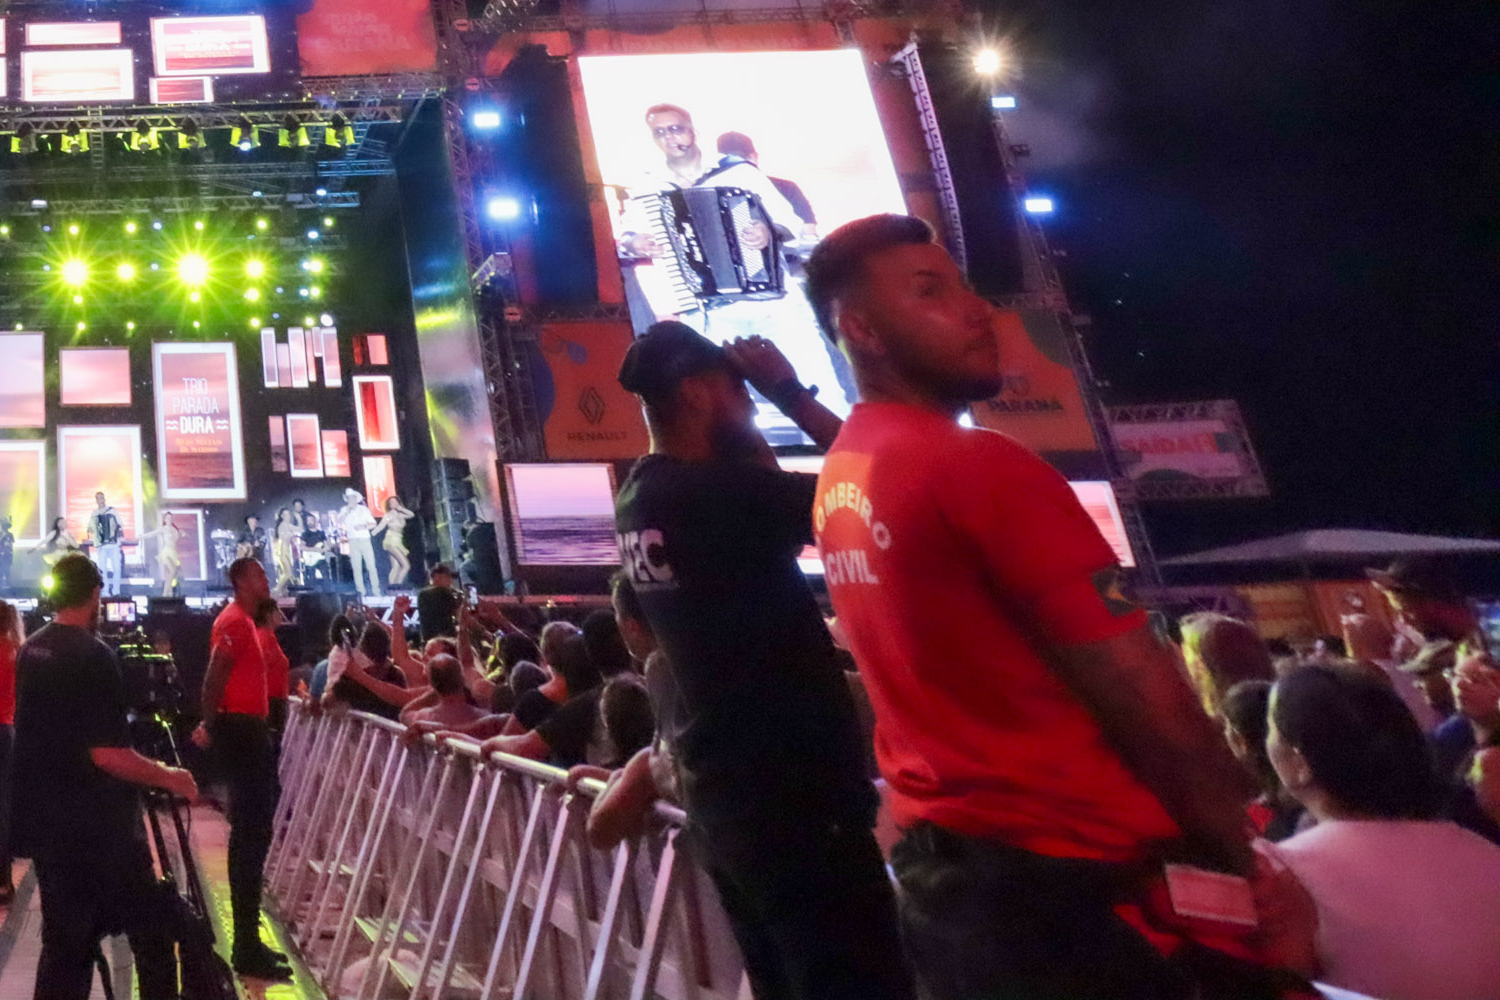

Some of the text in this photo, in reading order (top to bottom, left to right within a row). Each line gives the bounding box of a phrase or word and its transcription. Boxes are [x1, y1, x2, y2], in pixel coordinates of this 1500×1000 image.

[182, 378, 208, 395] TRIO
[172, 397, 219, 414] PARADA
[180, 416, 214, 434] DURA
[814, 482, 891, 550] OMBEIRO
[826, 549, 879, 586] CIVIL
